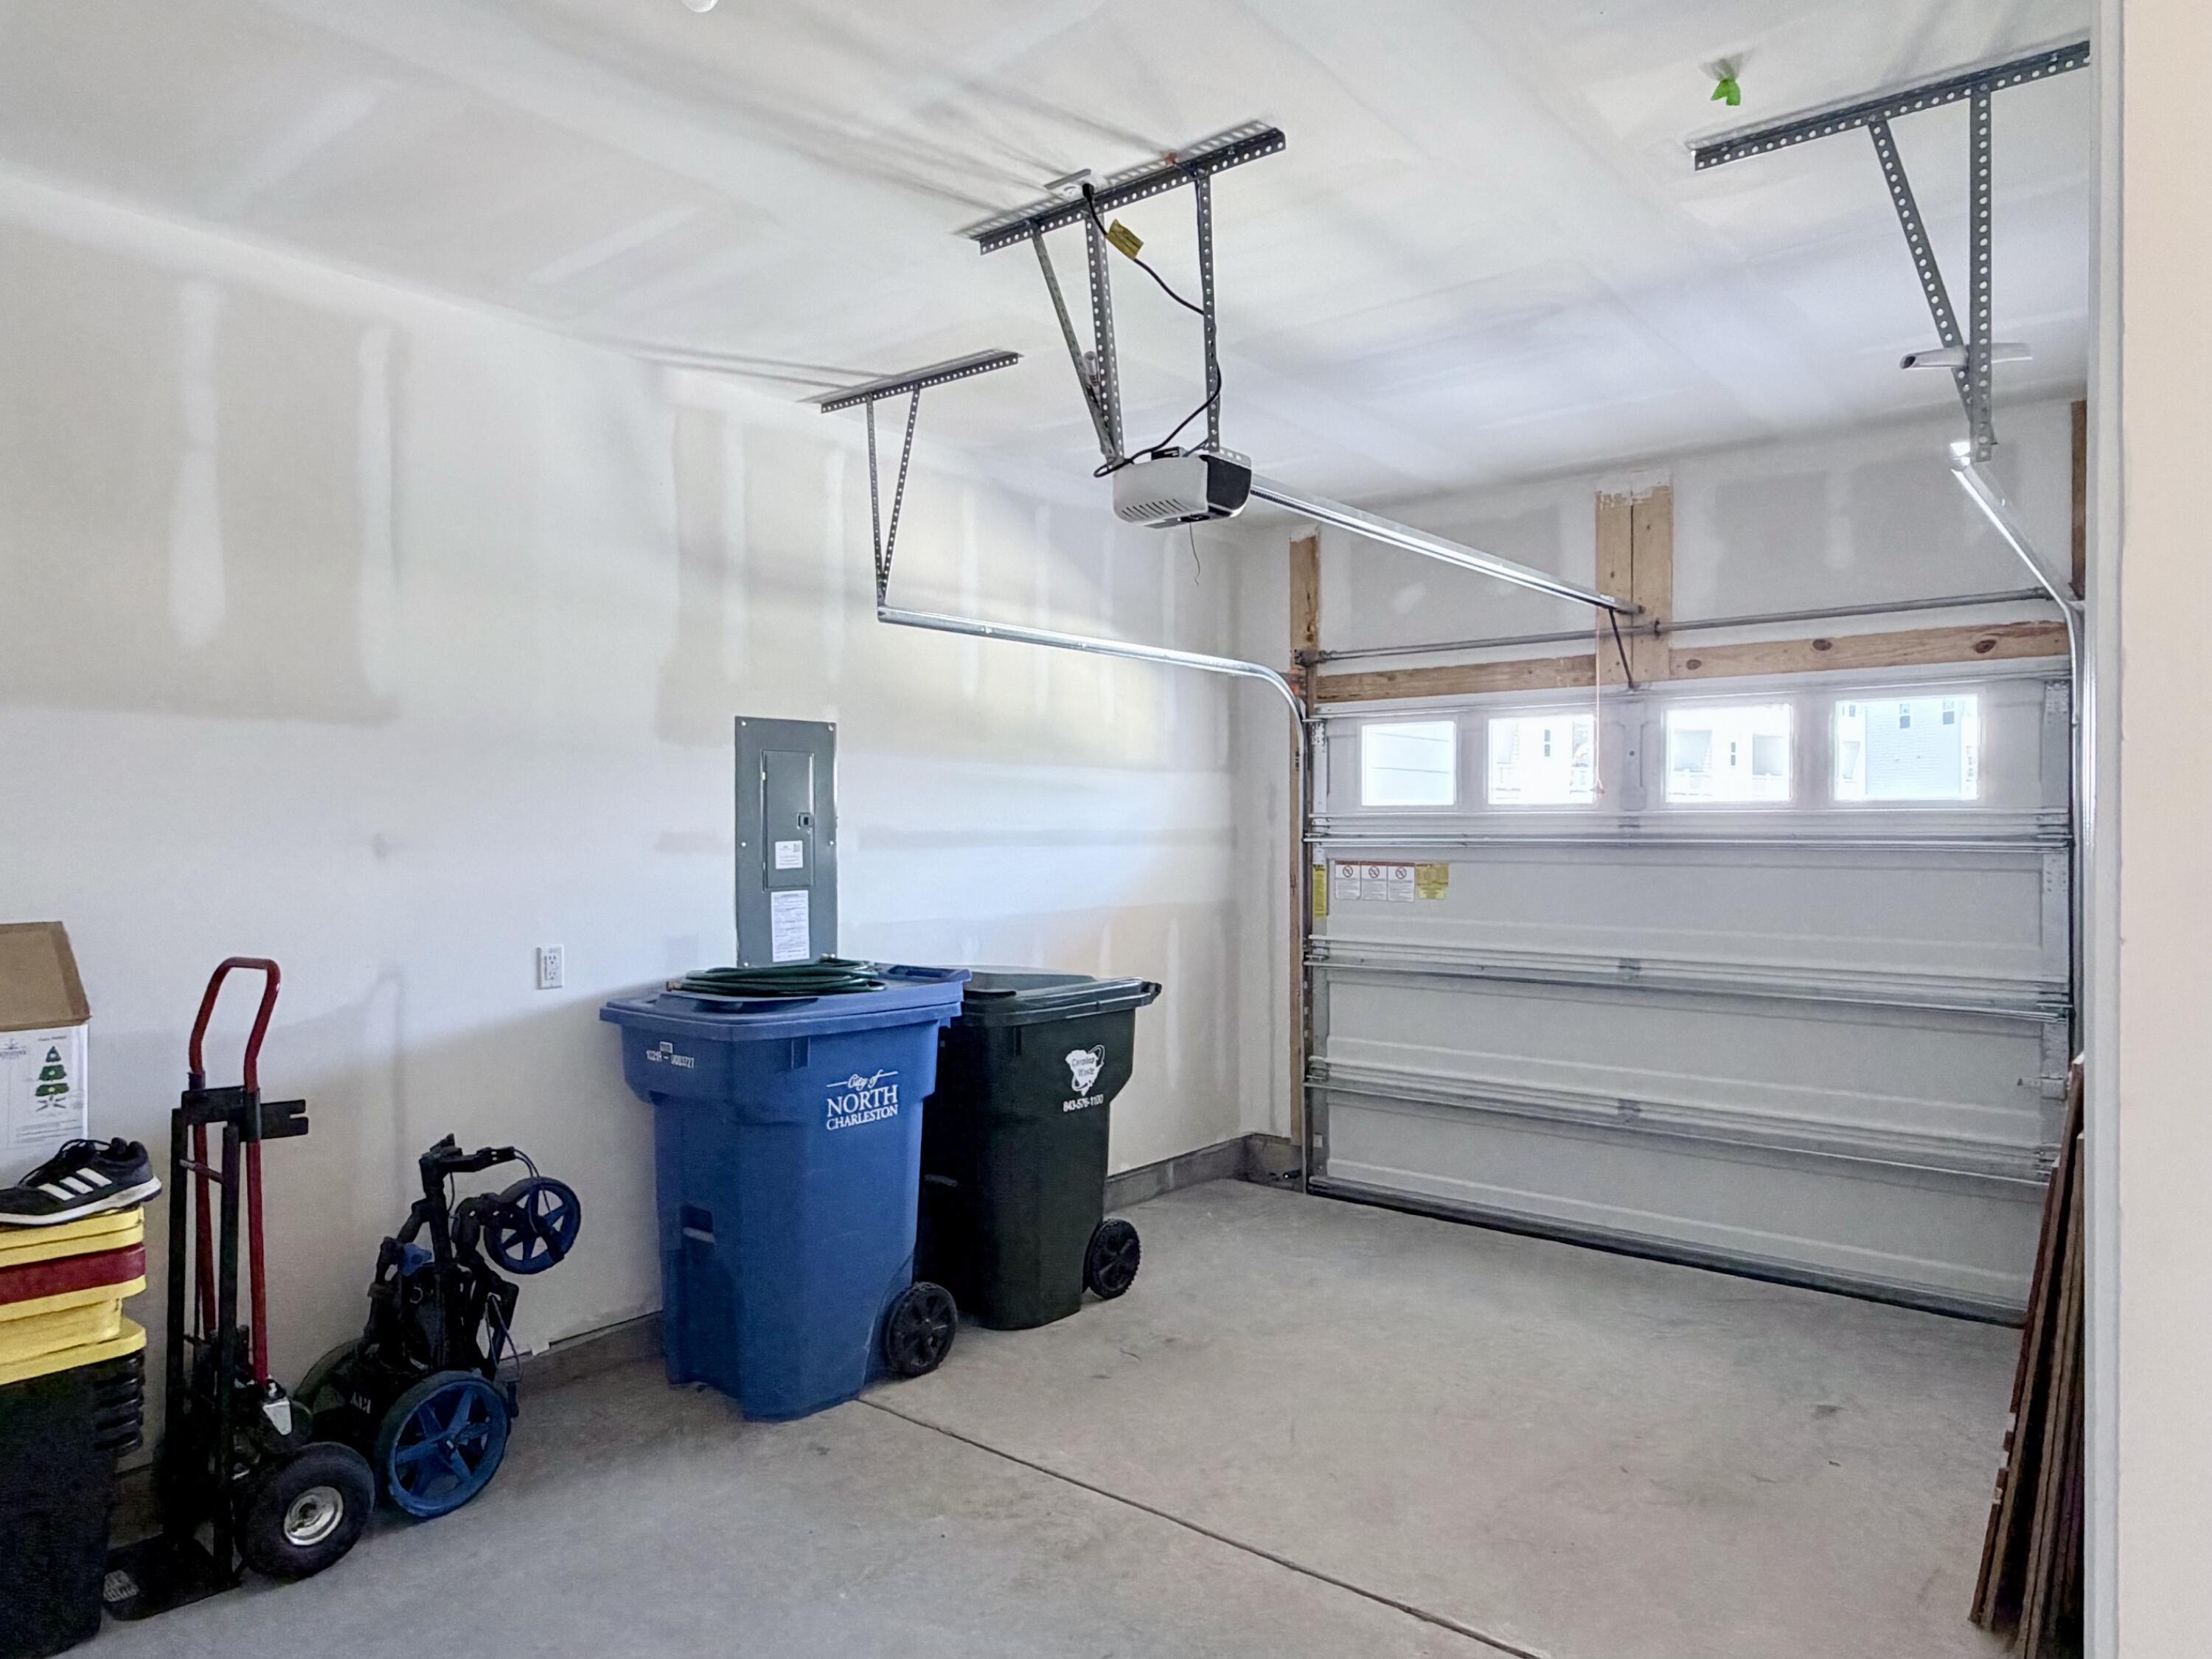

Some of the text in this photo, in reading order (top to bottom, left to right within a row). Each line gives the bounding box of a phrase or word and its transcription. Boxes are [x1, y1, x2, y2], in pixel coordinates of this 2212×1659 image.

[848, 1069, 884, 1091] City of
[827, 1084, 898, 1118] NORTH
[826, 1104, 898, 1130] CHARLESTON
